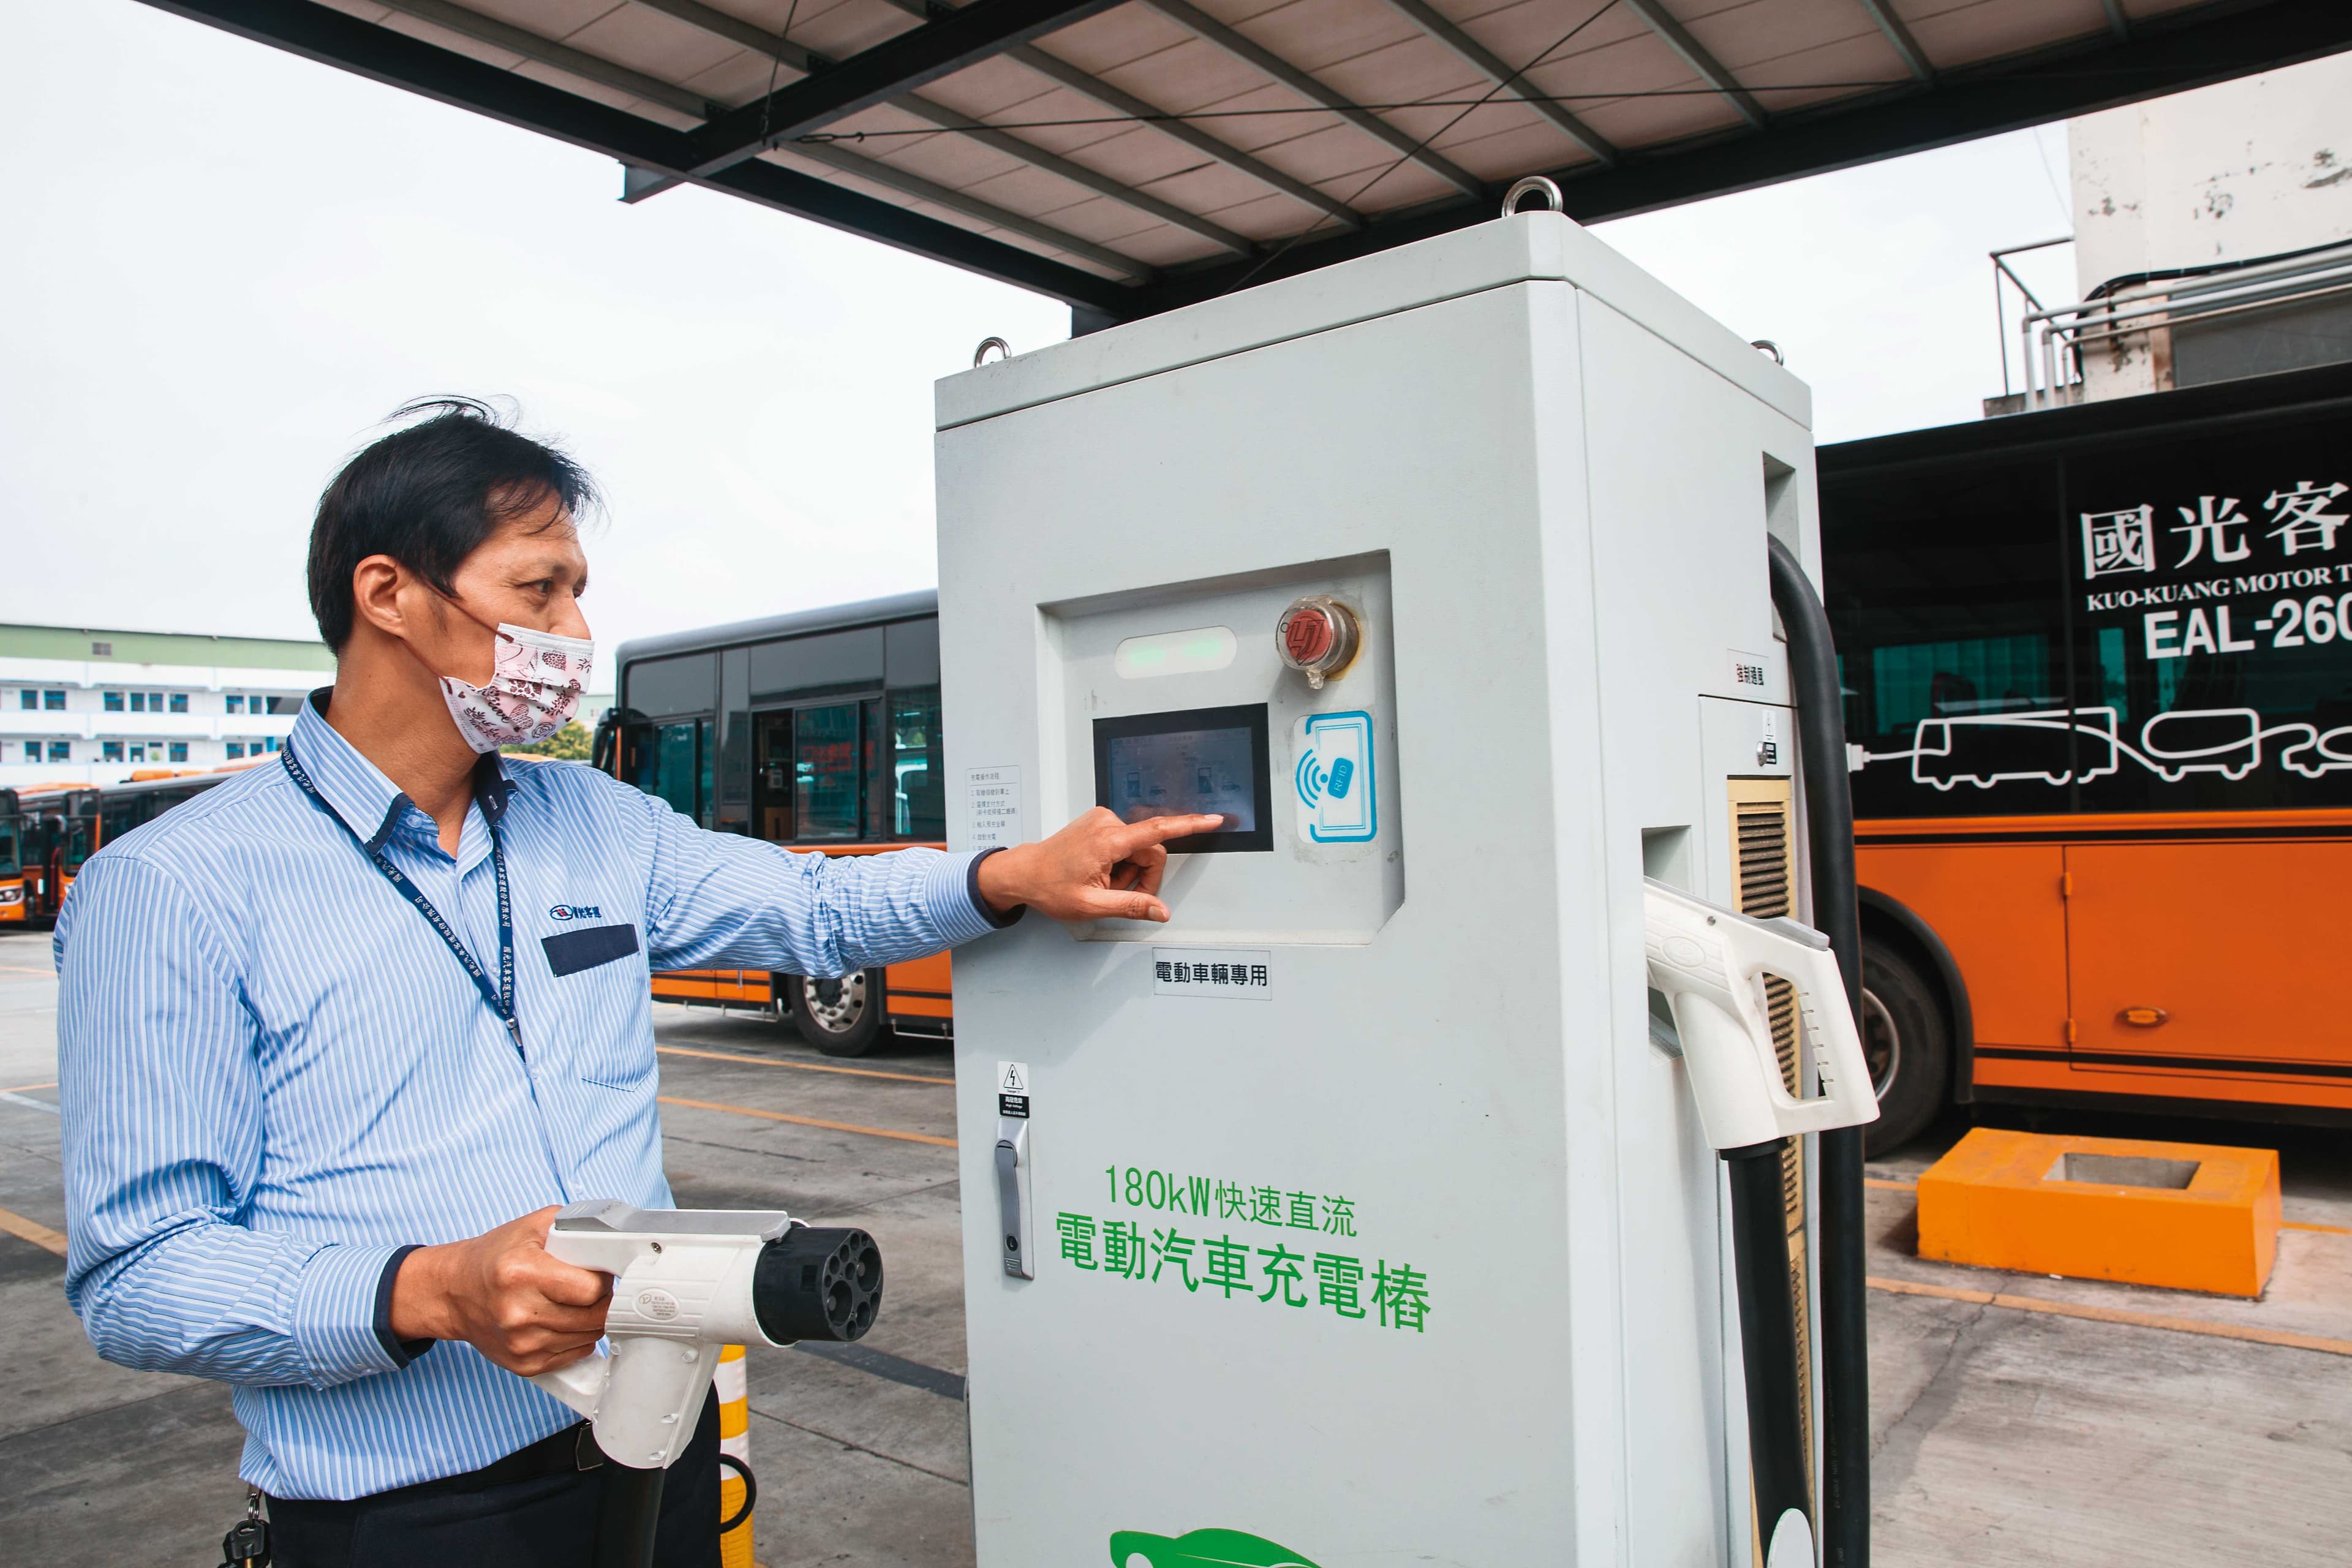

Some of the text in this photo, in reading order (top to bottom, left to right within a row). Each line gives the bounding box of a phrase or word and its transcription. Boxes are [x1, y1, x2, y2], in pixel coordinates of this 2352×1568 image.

[2086, 578, 2230, 611] KUO-KUANG
[2234, 568, 2332, 595] MOTOR
[1334, 764, 1348, 792] RFID
[1156, 962, 1268, 987] 電動車輛專用
[1106, 1164, 1358, 1238] 180kW快速直流
[1056, 1211, 1432, 1333] 電動汽車充電樁
